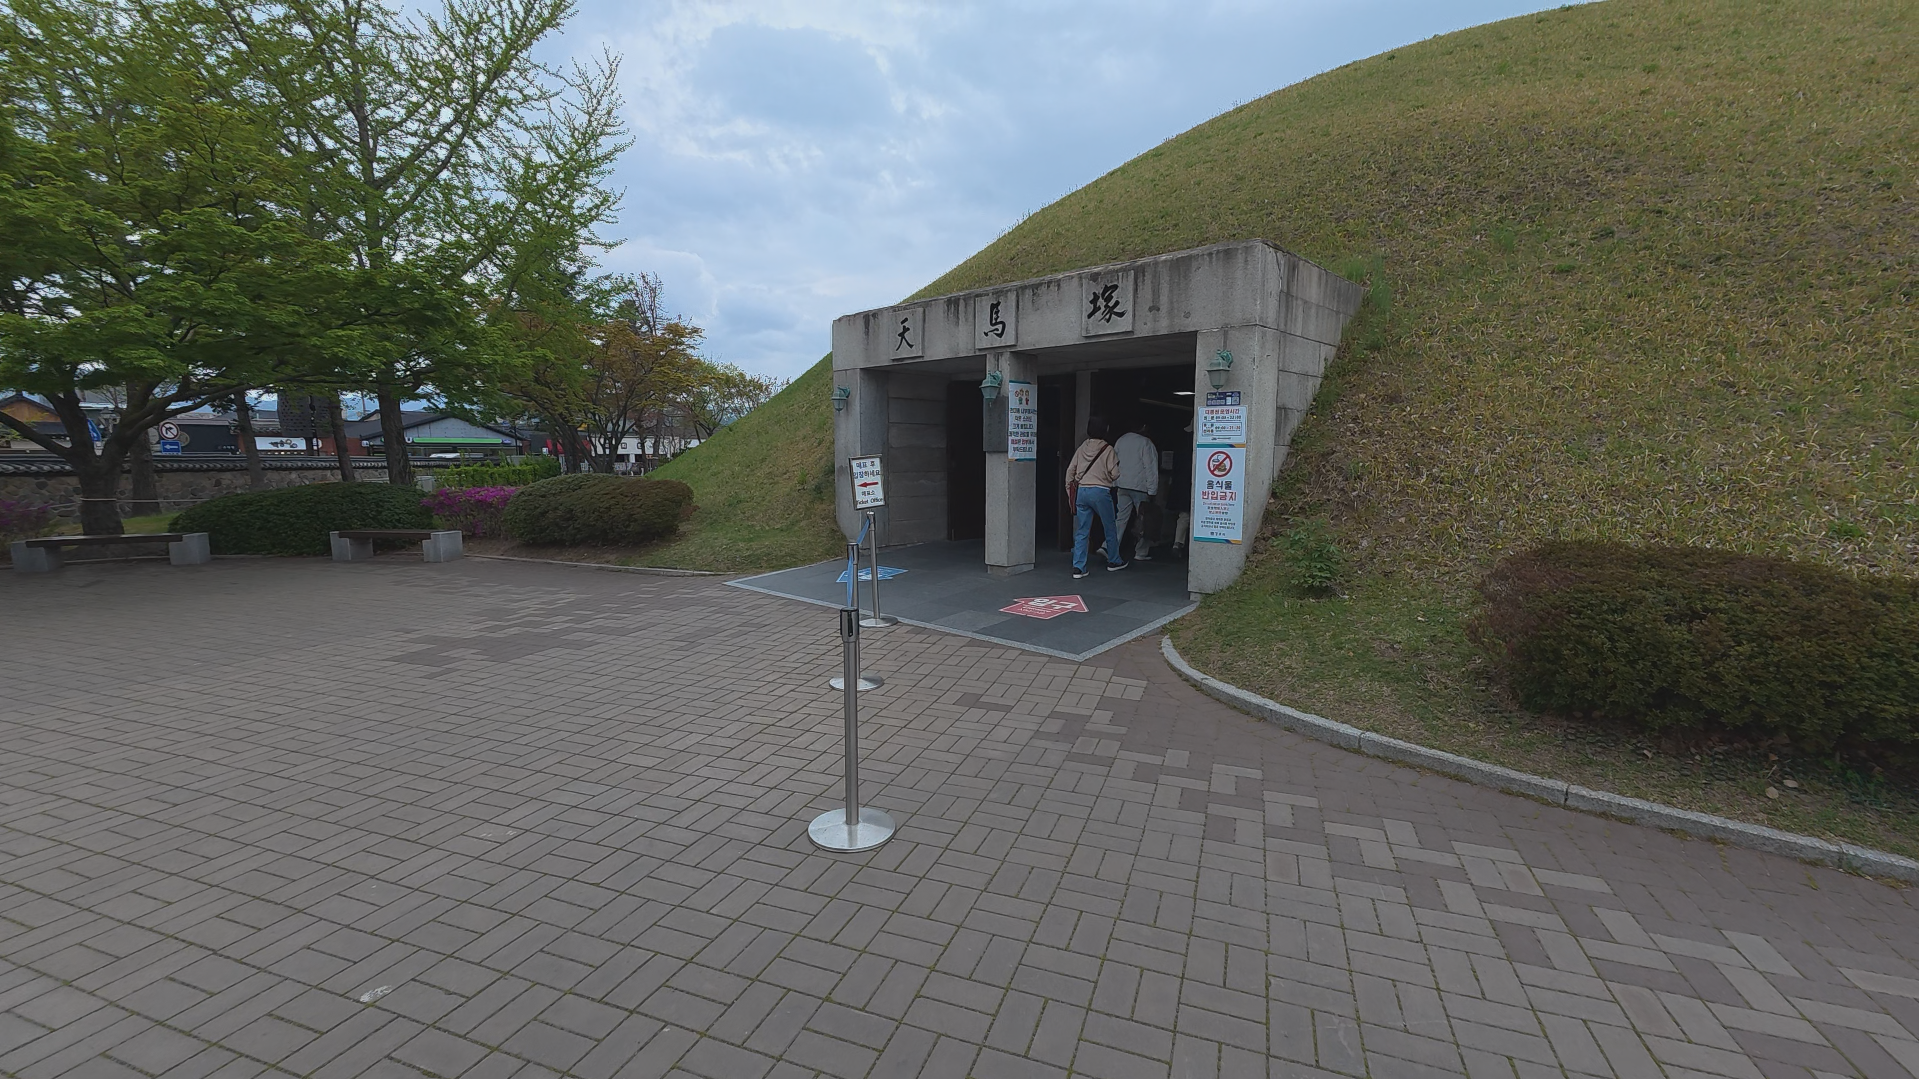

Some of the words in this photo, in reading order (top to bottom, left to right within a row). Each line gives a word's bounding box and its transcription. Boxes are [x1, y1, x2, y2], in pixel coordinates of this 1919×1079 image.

[853, 470, 880, 479] 입장하세요
[1206, 480, 1232, 490] 음식물
[1201, 490, 1237, 501] 반입금지
